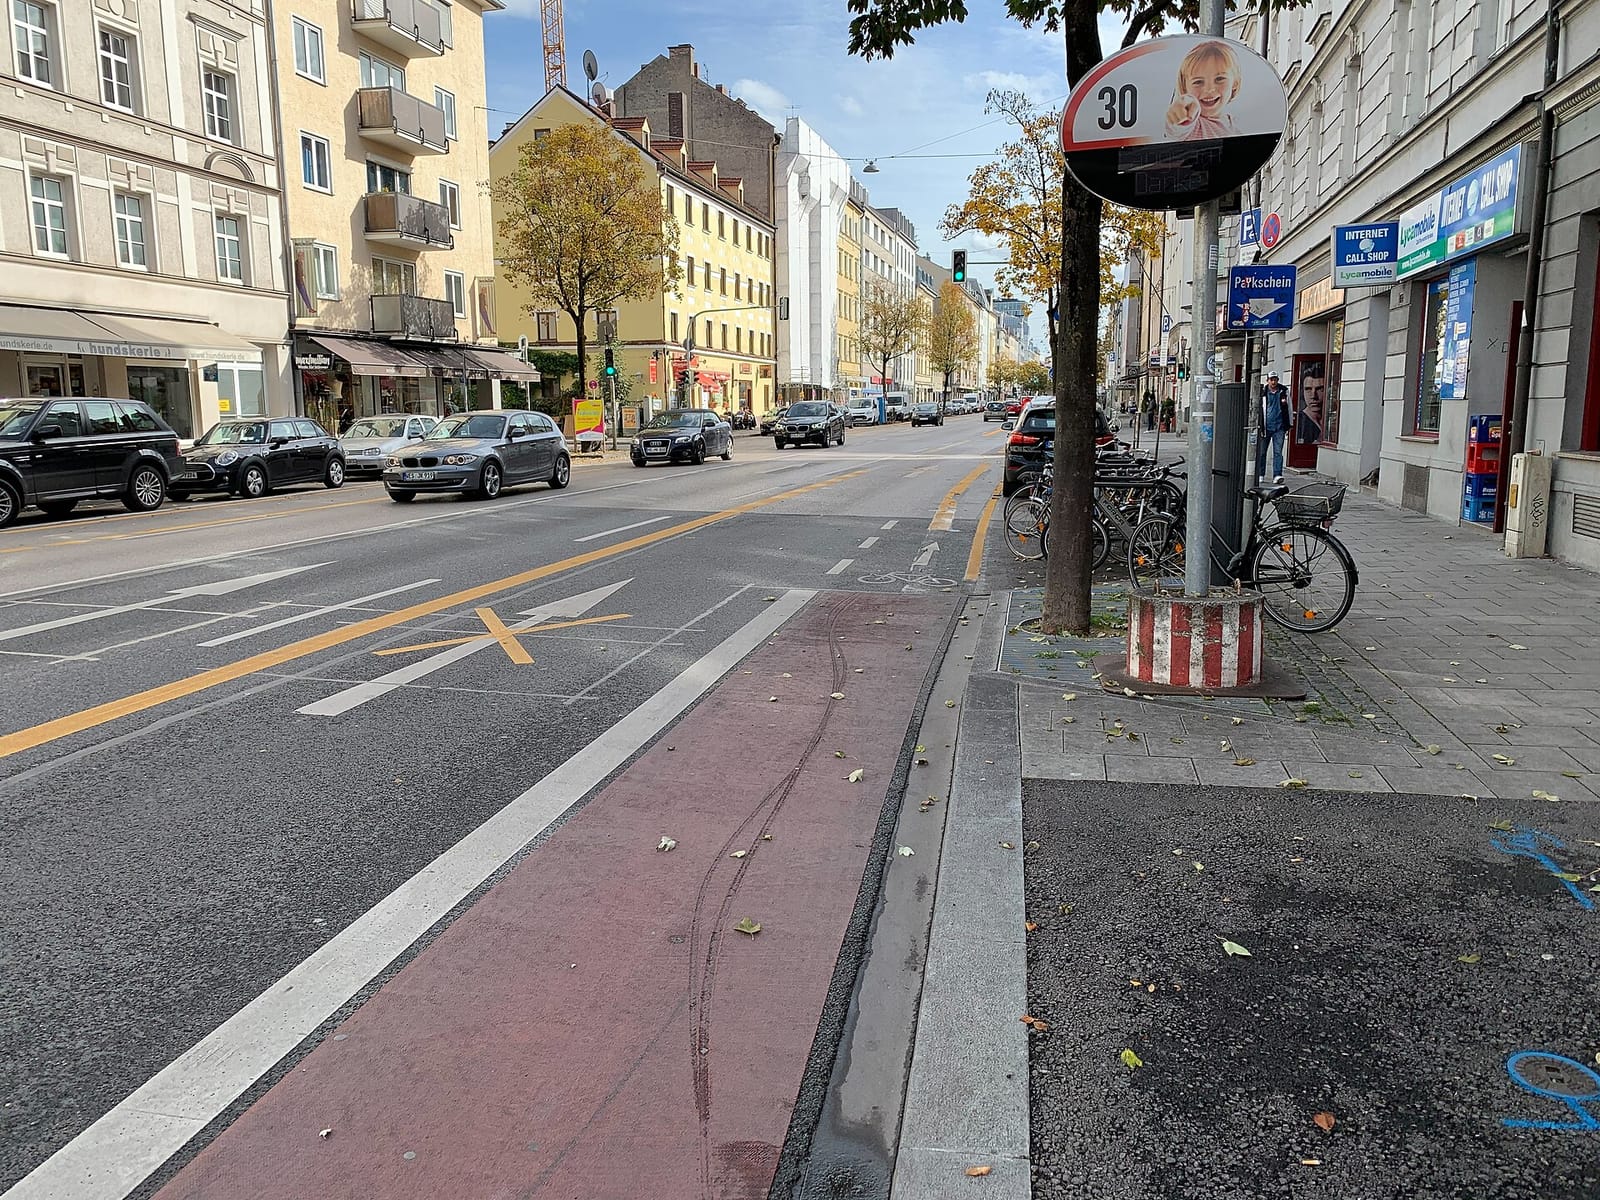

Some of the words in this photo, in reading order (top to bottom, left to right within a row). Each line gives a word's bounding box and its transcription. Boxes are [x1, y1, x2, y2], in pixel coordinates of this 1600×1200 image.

[1097, 83, 1138, 131] 30
[1345, 228, 1389, 241] INTERNET
[1345, 253, 1366, 264] CALL
[1367, 251, 1389, 262] SHOP
[1340, 266, 1393, 280] Lycamobile
[89, 342, 161, 357] hundskerle
